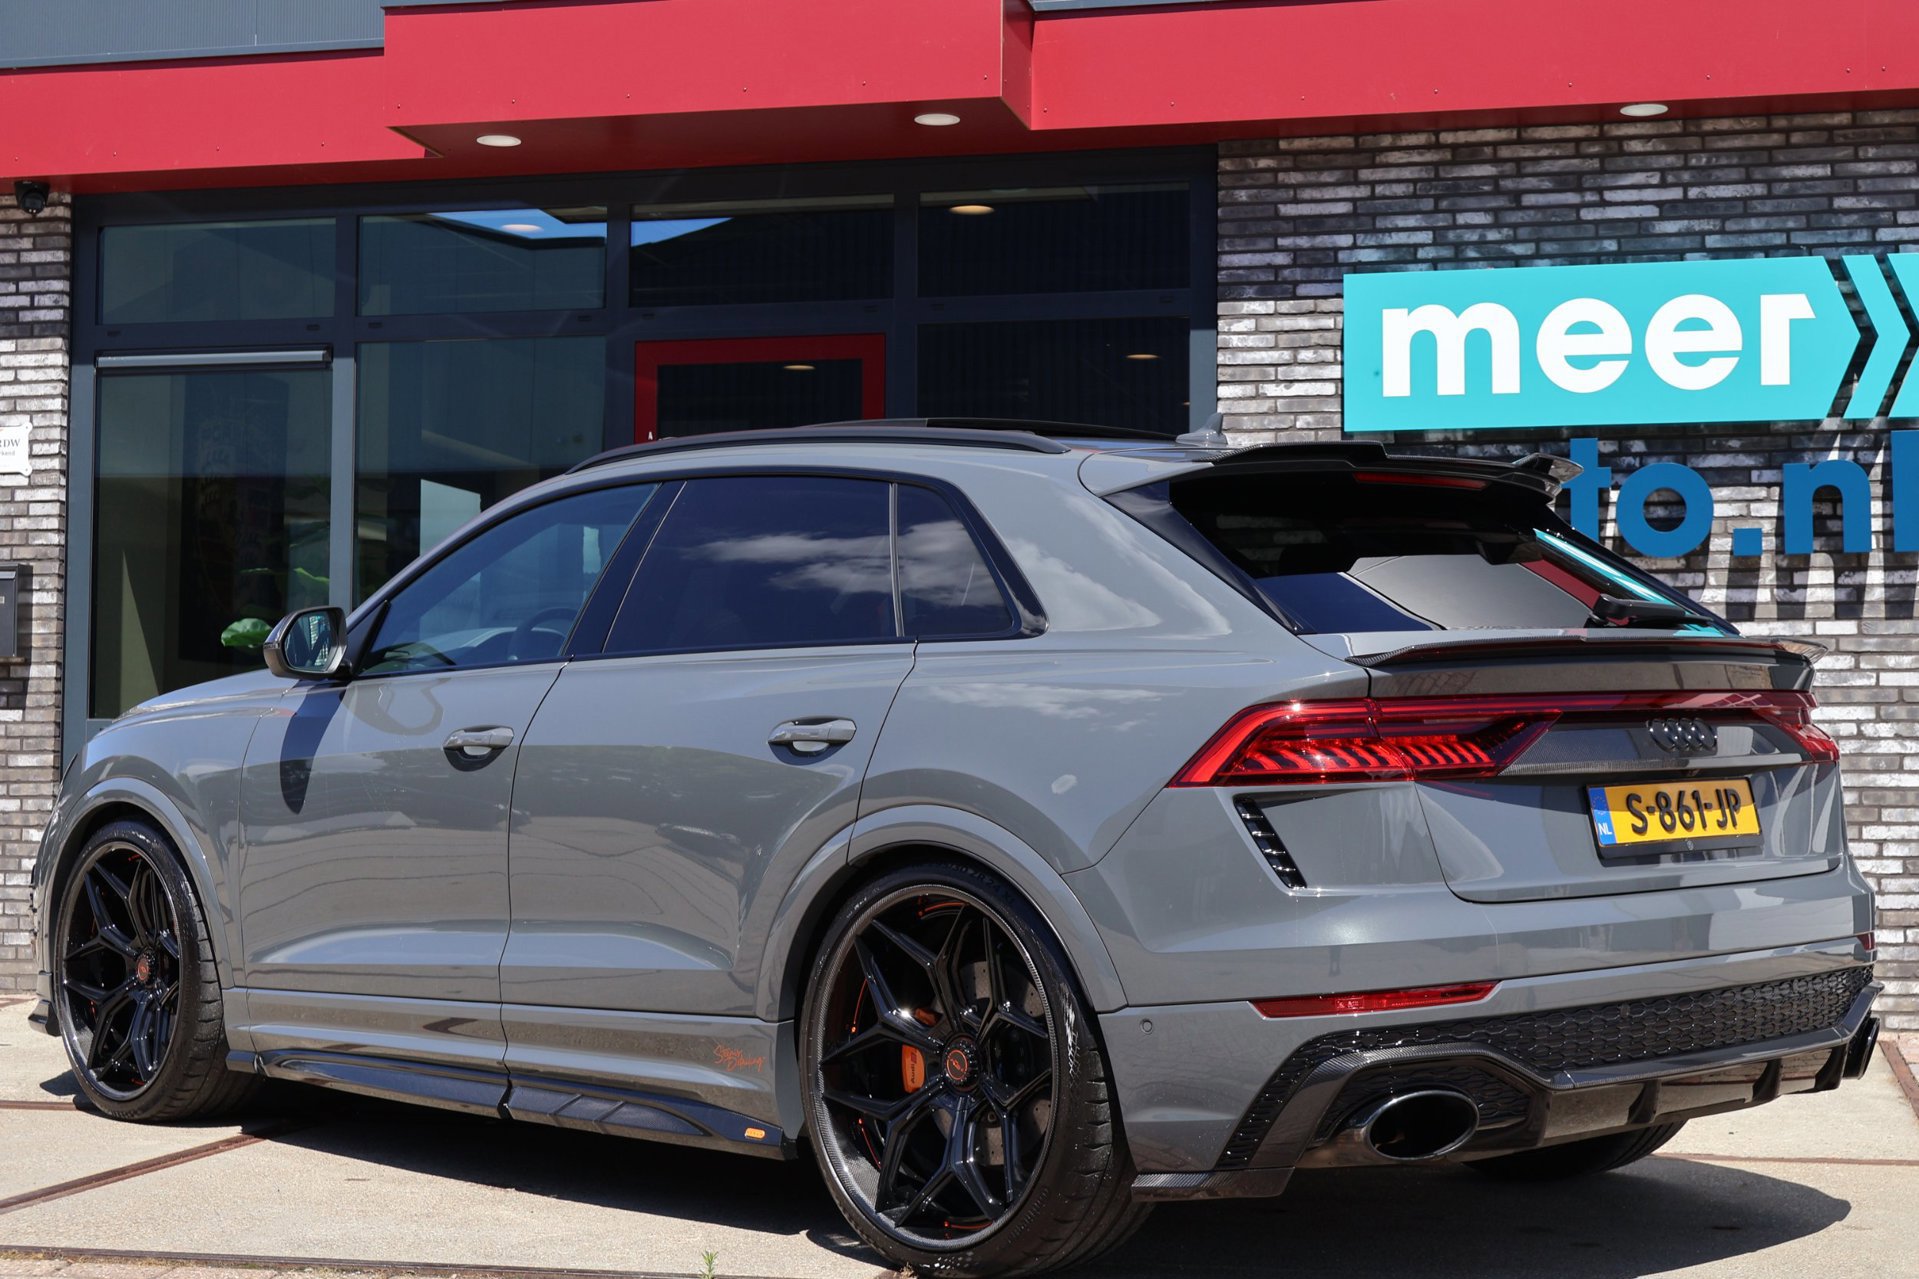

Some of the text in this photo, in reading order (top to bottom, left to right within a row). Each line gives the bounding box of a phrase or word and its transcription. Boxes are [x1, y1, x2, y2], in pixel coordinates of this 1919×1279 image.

[1382, 293, 1816, 397] meer
[0, 438, 20, 447] DW
[1626, 788, 1741, 834] S-861-JP
[1598, 822, 1612, 836] NL
